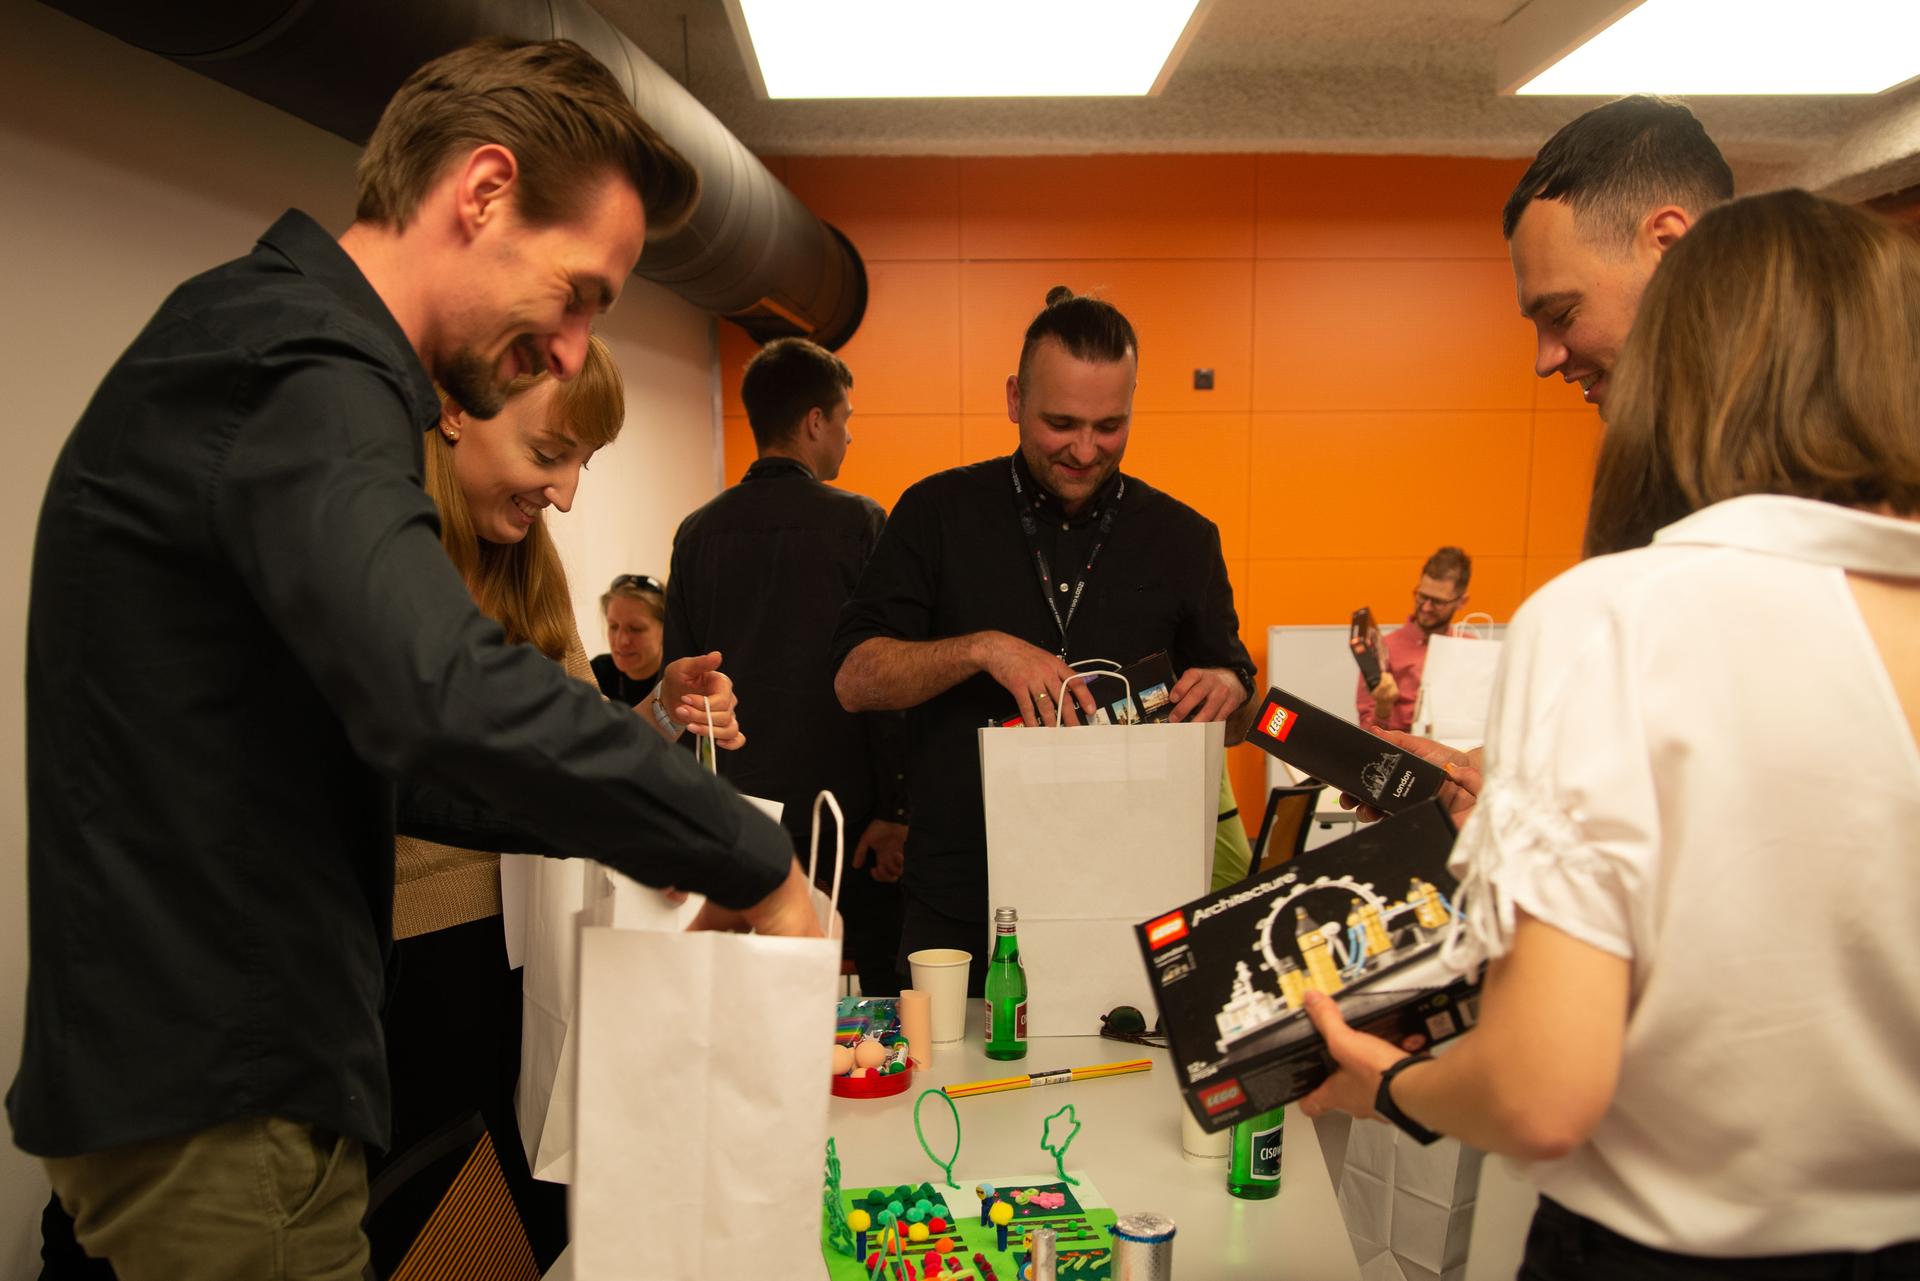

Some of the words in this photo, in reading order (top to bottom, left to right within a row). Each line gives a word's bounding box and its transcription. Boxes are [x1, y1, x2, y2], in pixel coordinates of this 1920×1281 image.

[1267, 707, 1288, 736] LEGO
[1392, 770, 1412, 798] London
[1192, 872, 1297, 927] Architecture
[1206, 1086, 1239, 1107] LEGO
